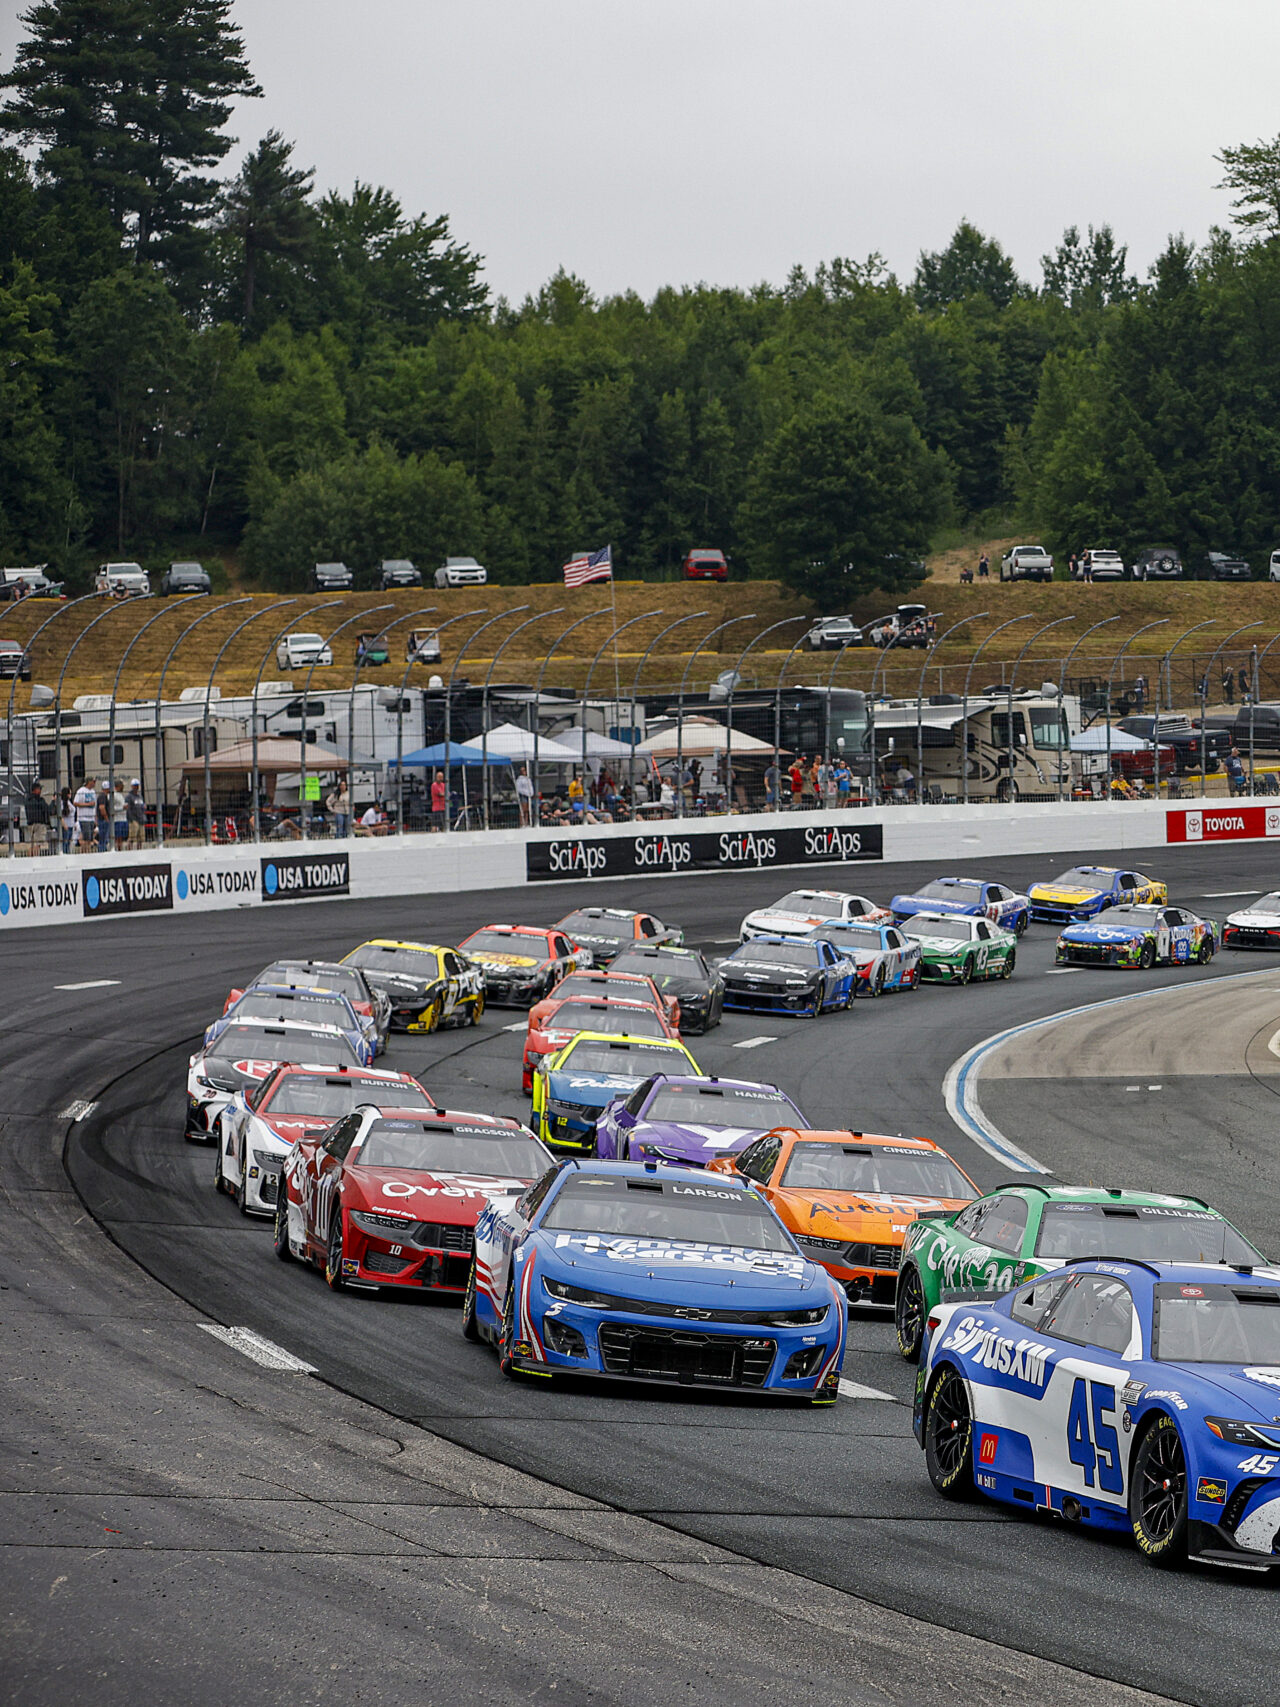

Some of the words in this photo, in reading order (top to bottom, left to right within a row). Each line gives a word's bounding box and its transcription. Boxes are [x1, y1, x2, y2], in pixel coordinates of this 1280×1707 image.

[1205, 816, 1245, 831] TOYOTA
[719, 832, 776, 867] SciAps
[804, 827, 861, 860] SciAps
[548, 841, 606, 877] SciAps
[634, 836, 691, 871] SciAps
[189, 873, 214, 894] USA
[215, 870, 257, 893] TODAY
[277, 867, 303, 889] USA
[303, 863, 347, 887] TODAY
[99, 879, 126, 902] USA
[126, 874, 169, 900] TODAY
[11, 886, 36, 910] USA
[37, 883, 79, 907] TODAY
[977, 945, 988, 970] 43
[300, 996, 335, 1005] ELLIOTT
[311, 1032, 338, 1041] BELL
[638, 1044, 673, 1052] BLANEY
[360, 1079, 408, 1090] BURTON
[735, 1090, 782, 1101] HAMLIN
[557, 1116, 568, 1126] 12
[455, 1126, 516, 1138] GRAGSON
[882, 1146, 932, 1157] CINDRIC
[672, 1186, 742, 1201] LARSON
[1141, 1206, 1217, 1221] GILLILAND
[389, 1244, 402, 1255] 10
[545, 1302, 568, 1316] 5
[942, 1316, 1056, 1387] SiriusXM
[1144, 1390, 1189, 1411] GOODYEAR
[1066, 1376, 1125, 1496] 45
[1236, 1454, 1280, 1475] 45
[1199, 1485, 1225, 1497] SUNOCO
